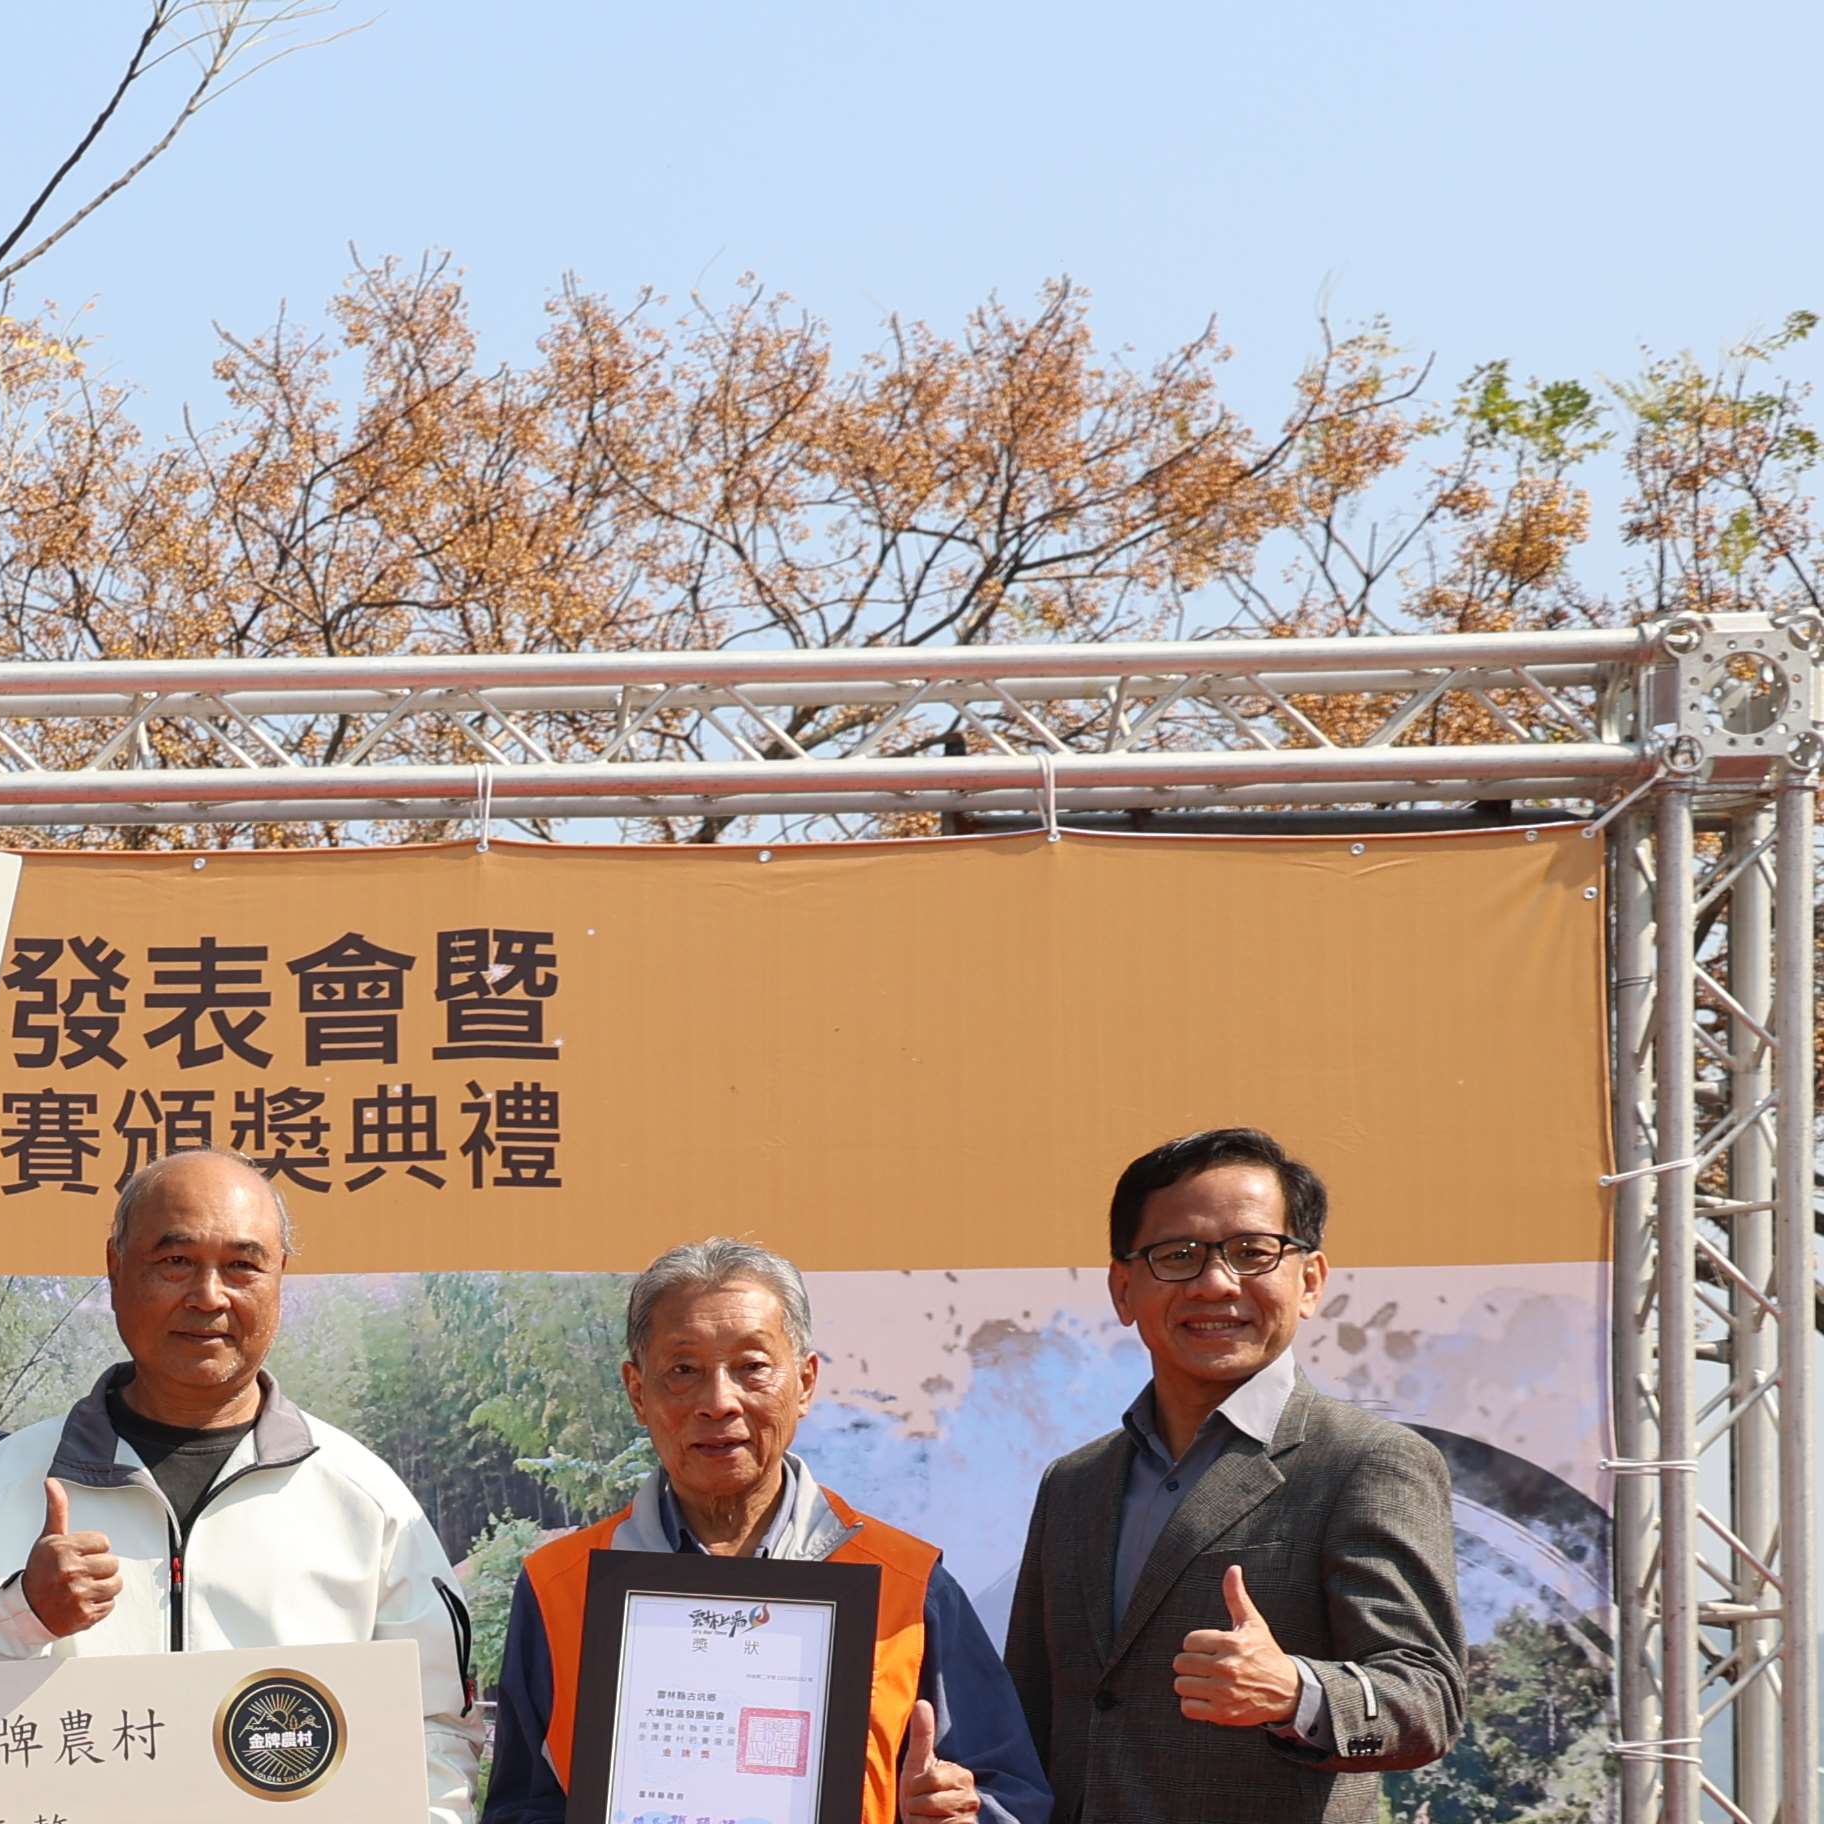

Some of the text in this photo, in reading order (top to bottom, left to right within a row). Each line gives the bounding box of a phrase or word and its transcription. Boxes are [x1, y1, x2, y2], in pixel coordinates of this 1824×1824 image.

[3, 927, 560, 1070] 發表會暨
[249, 1730, 312, 1749] 金牌農村
